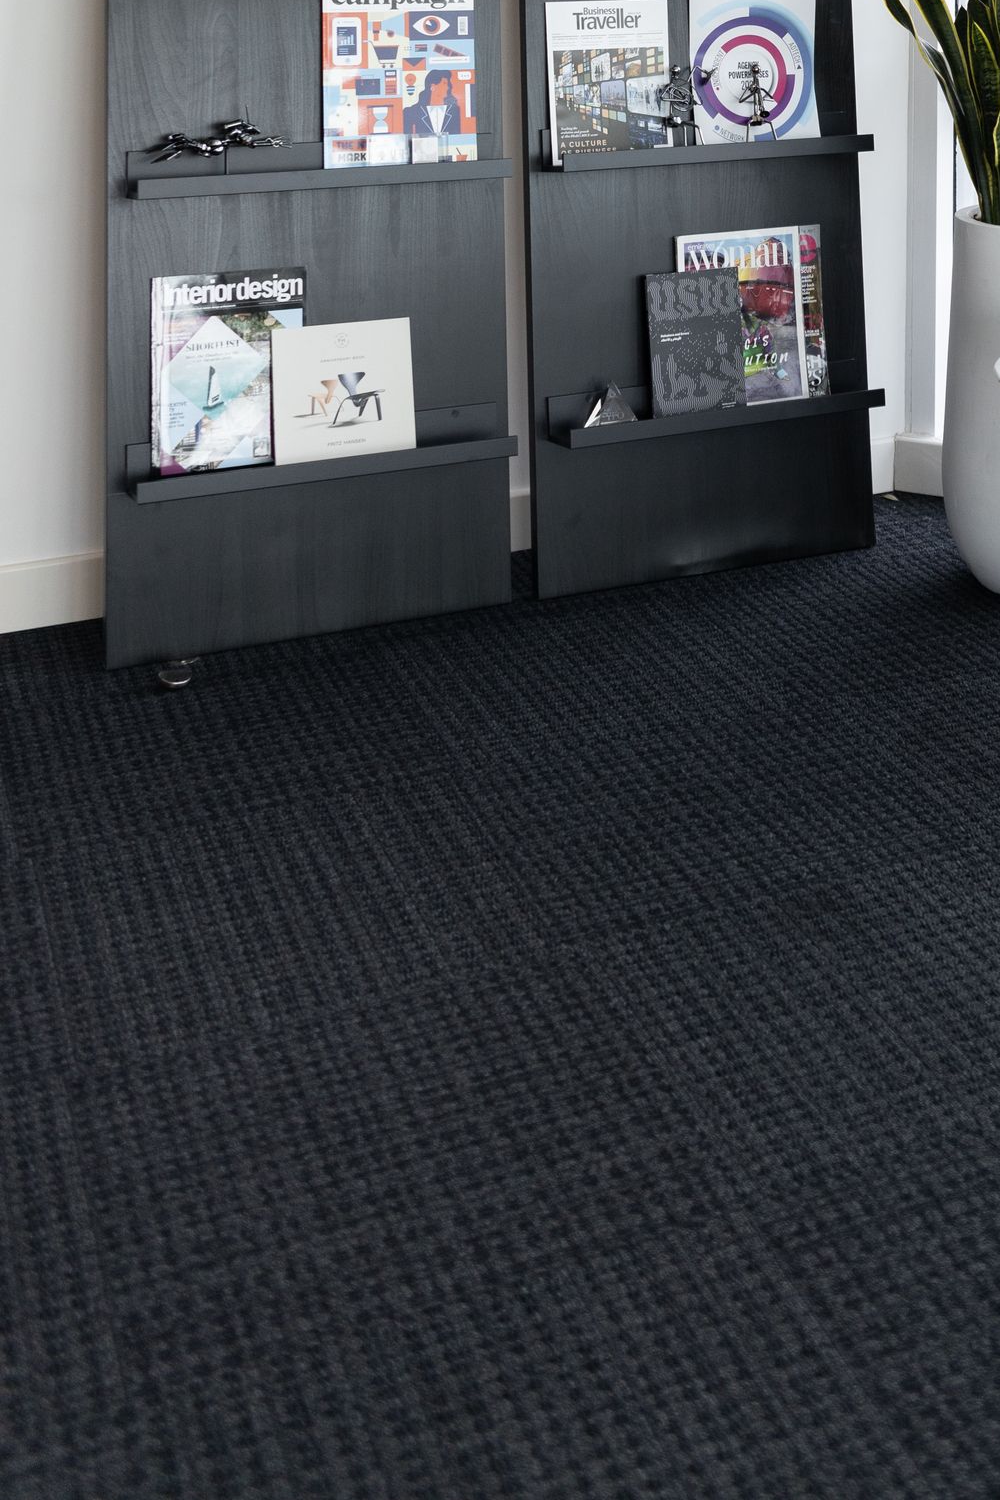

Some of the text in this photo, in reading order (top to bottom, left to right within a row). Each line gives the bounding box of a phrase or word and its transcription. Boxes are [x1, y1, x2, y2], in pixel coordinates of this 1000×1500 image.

[583, 6, 616, 15] Business
[572, 8, 642, 31] Traveller
[560, 139, 608, 149] A CULTURE
[687, 241, 789, 271] woman
[186, 340, 240, 352] SHORTLIST
[745, 352, 789, 367] UTION
